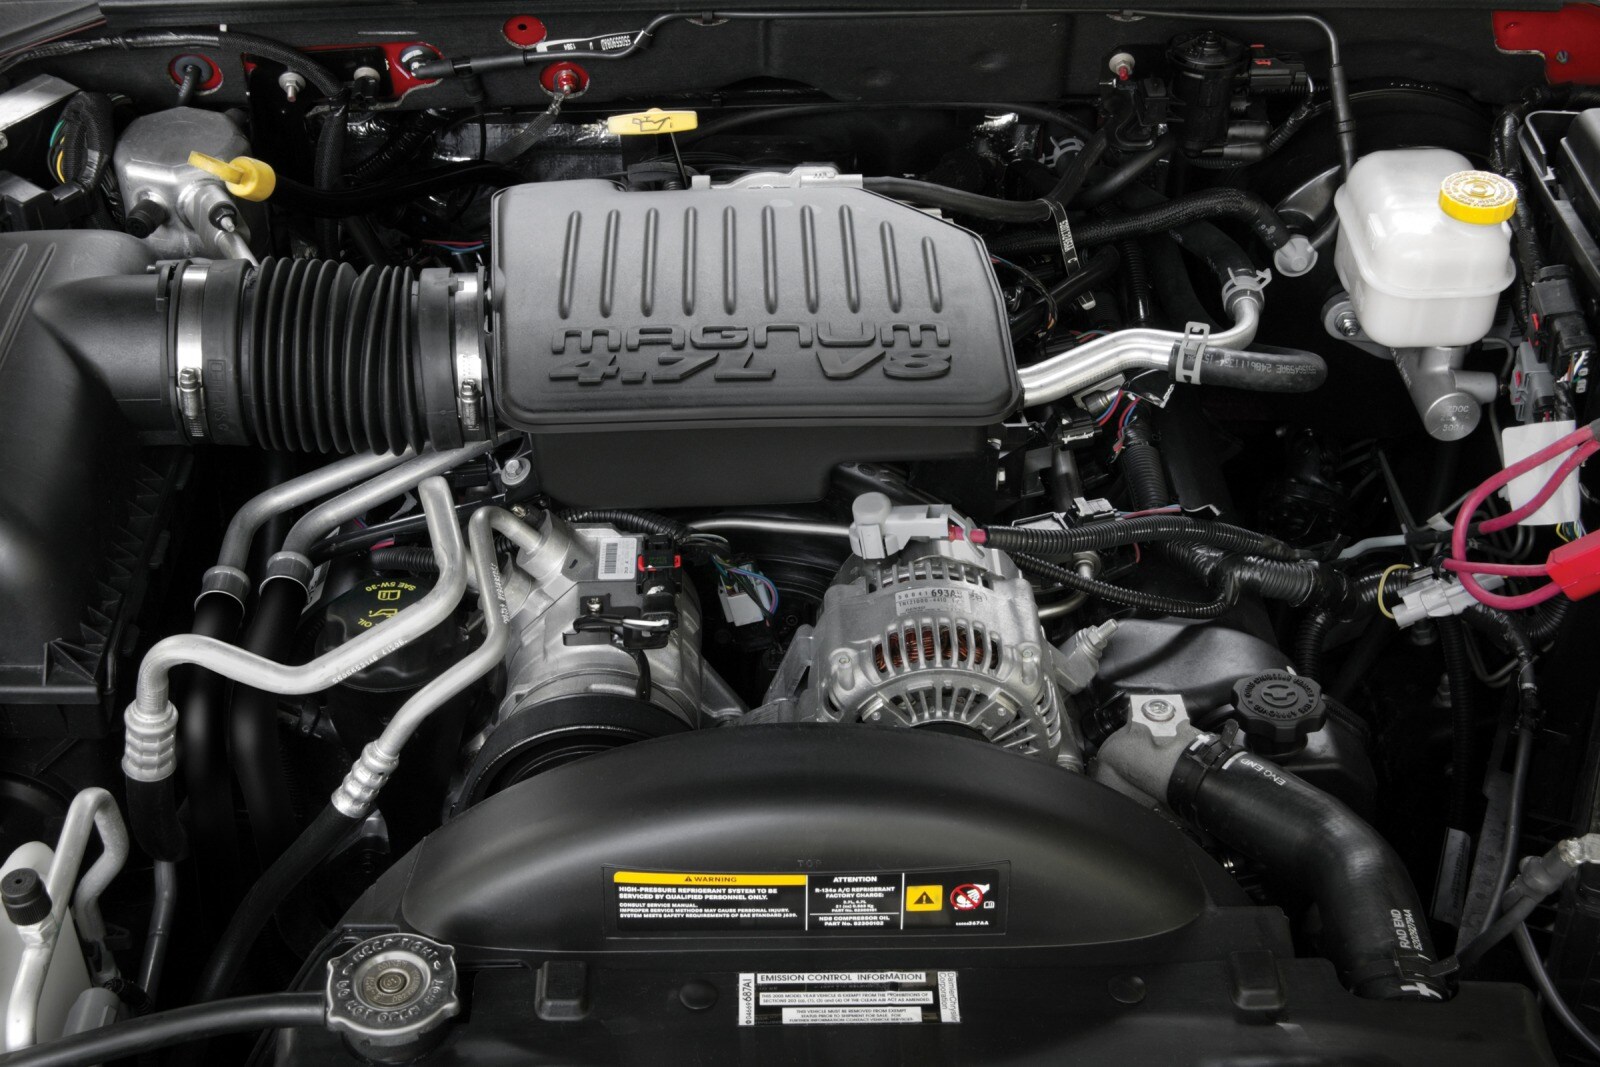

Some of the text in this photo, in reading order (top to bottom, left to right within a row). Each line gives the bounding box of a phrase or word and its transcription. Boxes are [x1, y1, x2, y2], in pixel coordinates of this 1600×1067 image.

[551, 320, 951, 354] MAGNUM
[548, 348, 953, 386] 4.7L V8
[364, 581, 416, 592] SAE 5W-30
[357, 617, 373, 628] OIL
[1240, 758, 1286, 786] ENG END
[1390, 909, 1411, 948] RAD END
[858, 973, 922, 981] INFORMATION
[939, 973, 948, 1009] Corporation
